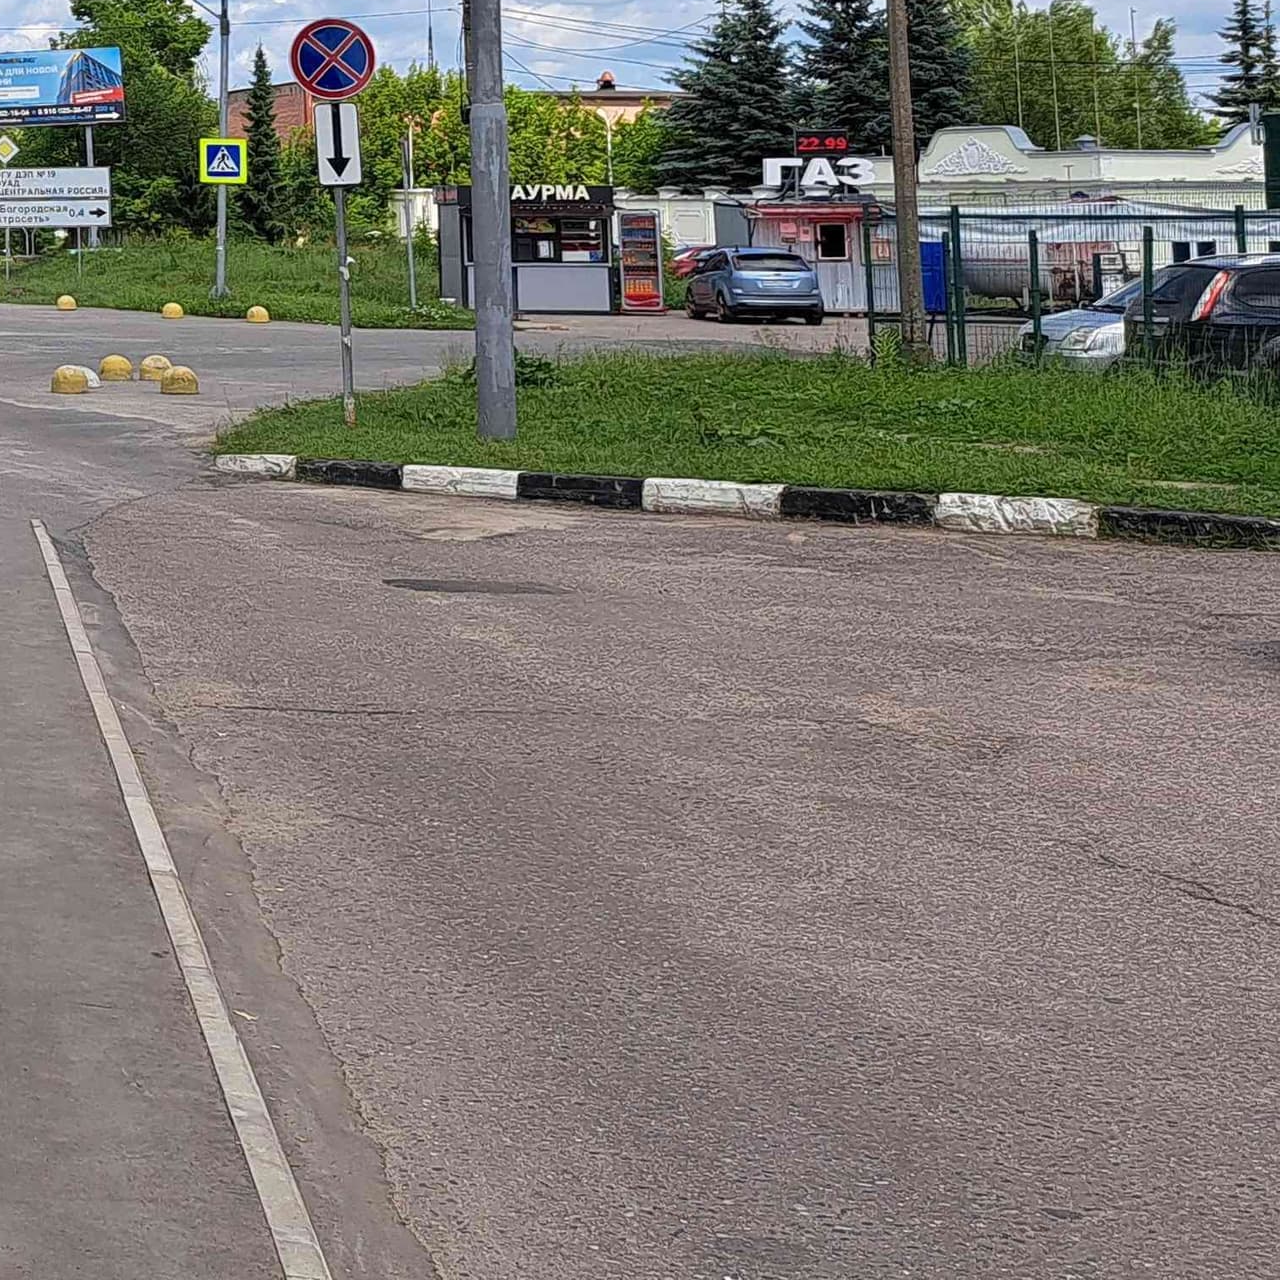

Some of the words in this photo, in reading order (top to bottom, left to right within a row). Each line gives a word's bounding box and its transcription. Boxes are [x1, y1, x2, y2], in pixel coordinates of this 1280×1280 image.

[4, 66, 24, 77] ДЛЯ
[25, 64, 58, 74] НОВОЙ
[15, 170, 34, 179] ДЭП
[762, 157, 876, 186] ГАЗ
[511, 184, 590, 201] АУРМА
[68, 208, 85, 218] 0,4
